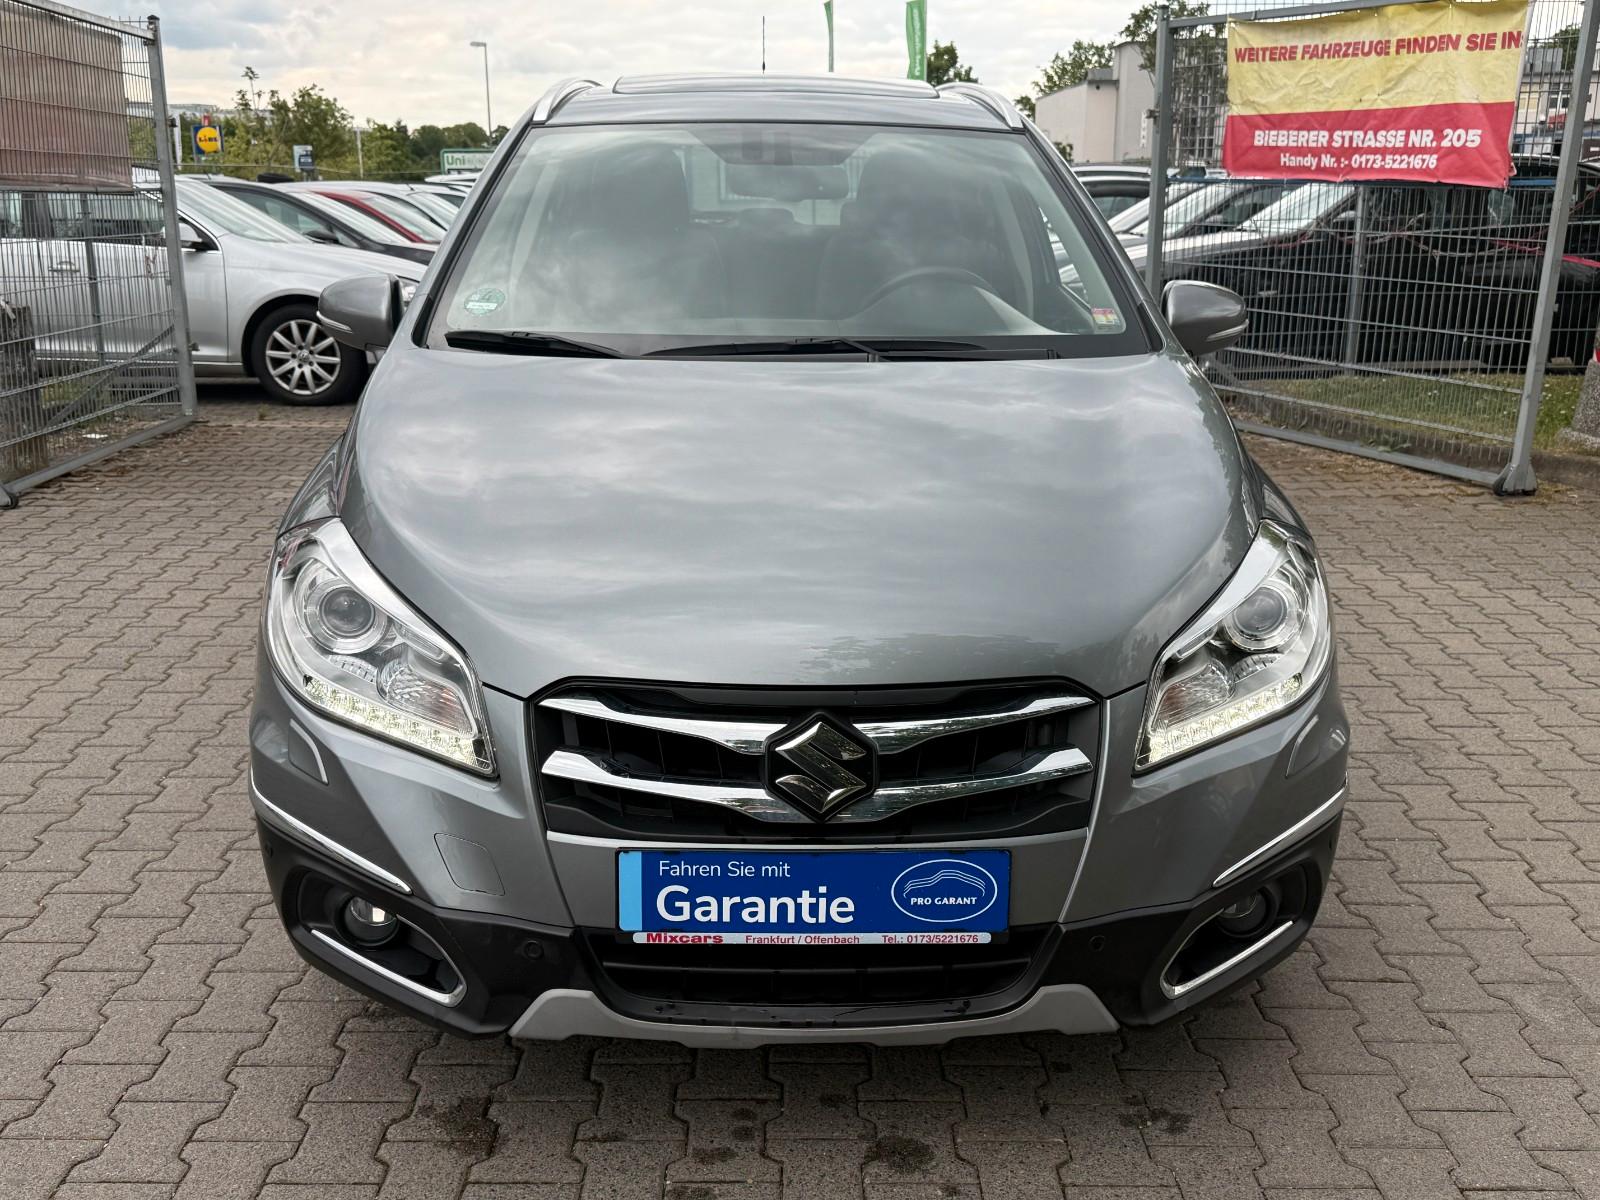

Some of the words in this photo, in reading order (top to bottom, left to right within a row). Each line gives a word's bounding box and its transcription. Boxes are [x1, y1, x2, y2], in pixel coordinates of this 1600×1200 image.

[1235, 45, 1298, 62] WEITERE
[1301, 40, 1391, 60] FAHRZEUGE
[1395, 34, 1461, 55] FINDEN
[1465, 32, 1497, 52] SIE
[1332, 130, 1406, 148] STRASSE
[1408, 129, 1437, 148] NR.
[1440, 128, 1482, 148] 205
[1280, 153, 1318, 170] Handy
[1321, 154, 1337, 168] Nr.
[1351, 154, 1438, 168] 0173-5221676
[659, 860, 721, 877] Fahren
[727, 861, 755, 877] Sie
[761, 861, 791, 877] mit
[656, 884, 855, 923] Garantie
[910, 897, 932, 905] PRO
[934, 897, 977, 905] GARANT
[646, 932, 724, 944] Mixcars
[745, 935, 793, 944] Frankfurt
[804, 935, 860, 944] Offenbach
[882, 935, 903, 944] Tel.:
[906, 934, 979, 944] 0173/5221676
